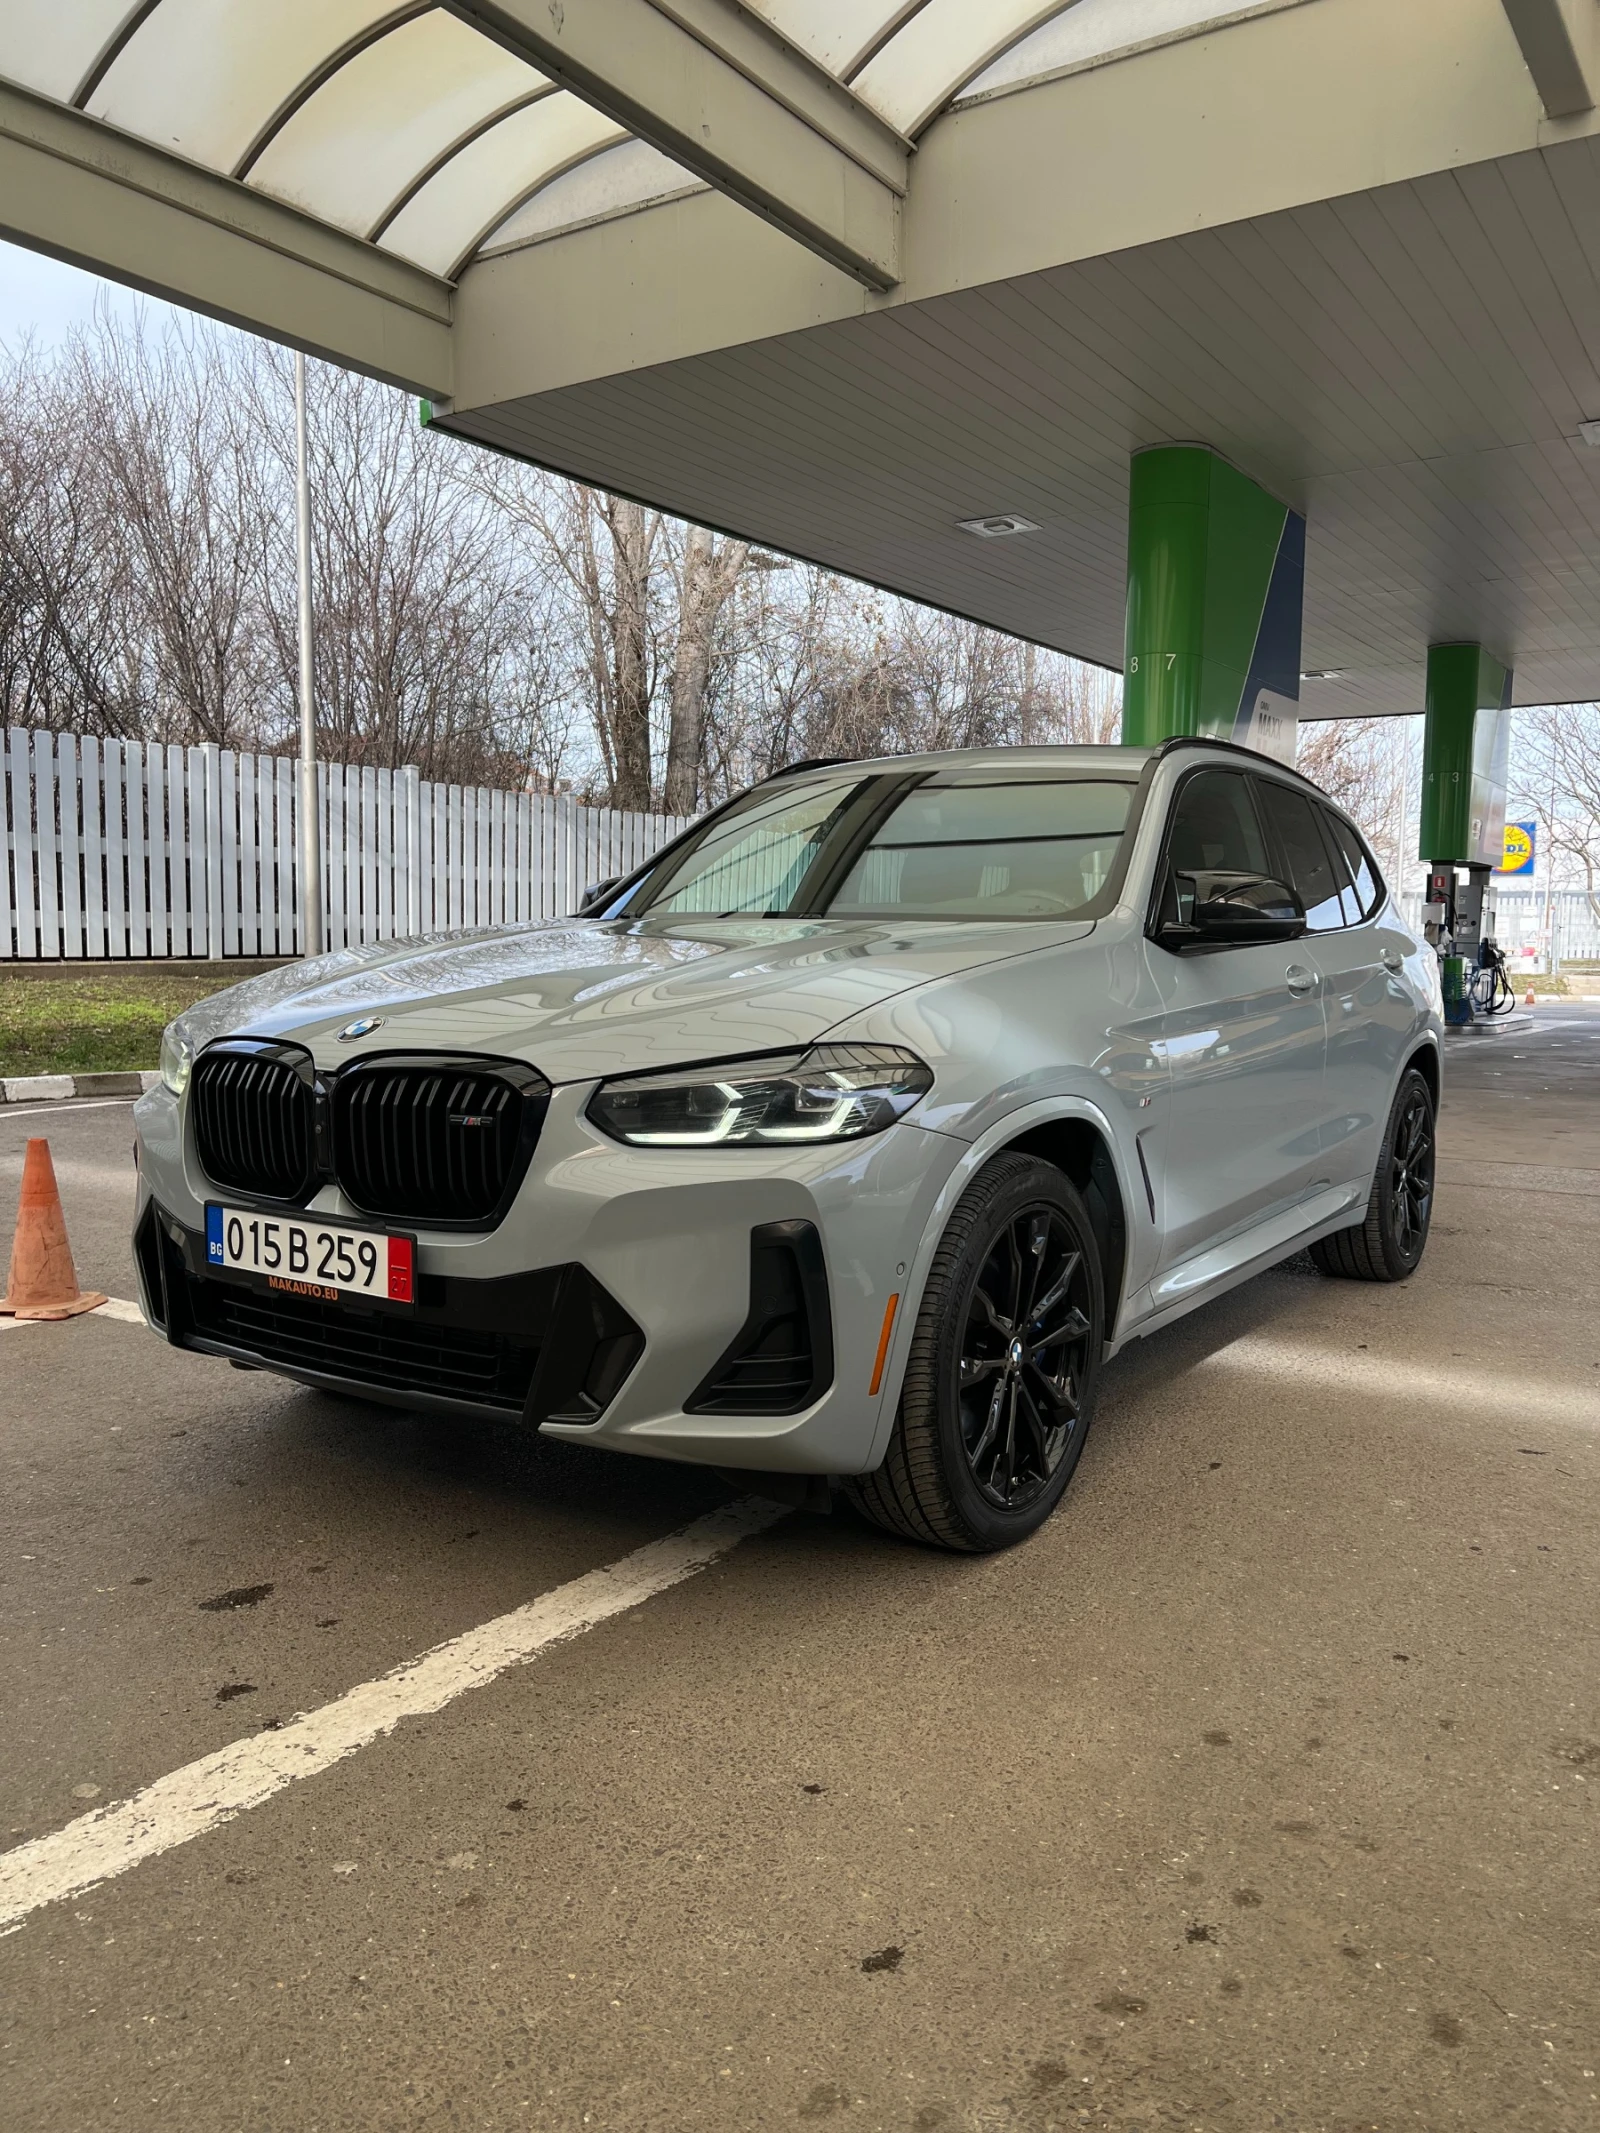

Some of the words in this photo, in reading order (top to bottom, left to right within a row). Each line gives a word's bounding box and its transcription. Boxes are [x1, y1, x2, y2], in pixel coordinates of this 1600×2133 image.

[1131, 656, 1139, 673] 8
[1165, 653, 1176, 671] 7
[1258, 713, 1283, 740] MAXX
[1428, 773, 1434, 782] 4
[1452, 772, 1459, 782] 3
[1506, 844, 1527, 853] DL
[209, 1241, 223, 1256] BG
[227, 1217, 282, 1268] 015
[289, 1226, 309, 1274] B
[316, 1232, 377, 1287] 259
[268, 1275, 339, 1301] MAKAUTO.EU
[391, 1276, 407, 1294] 27
